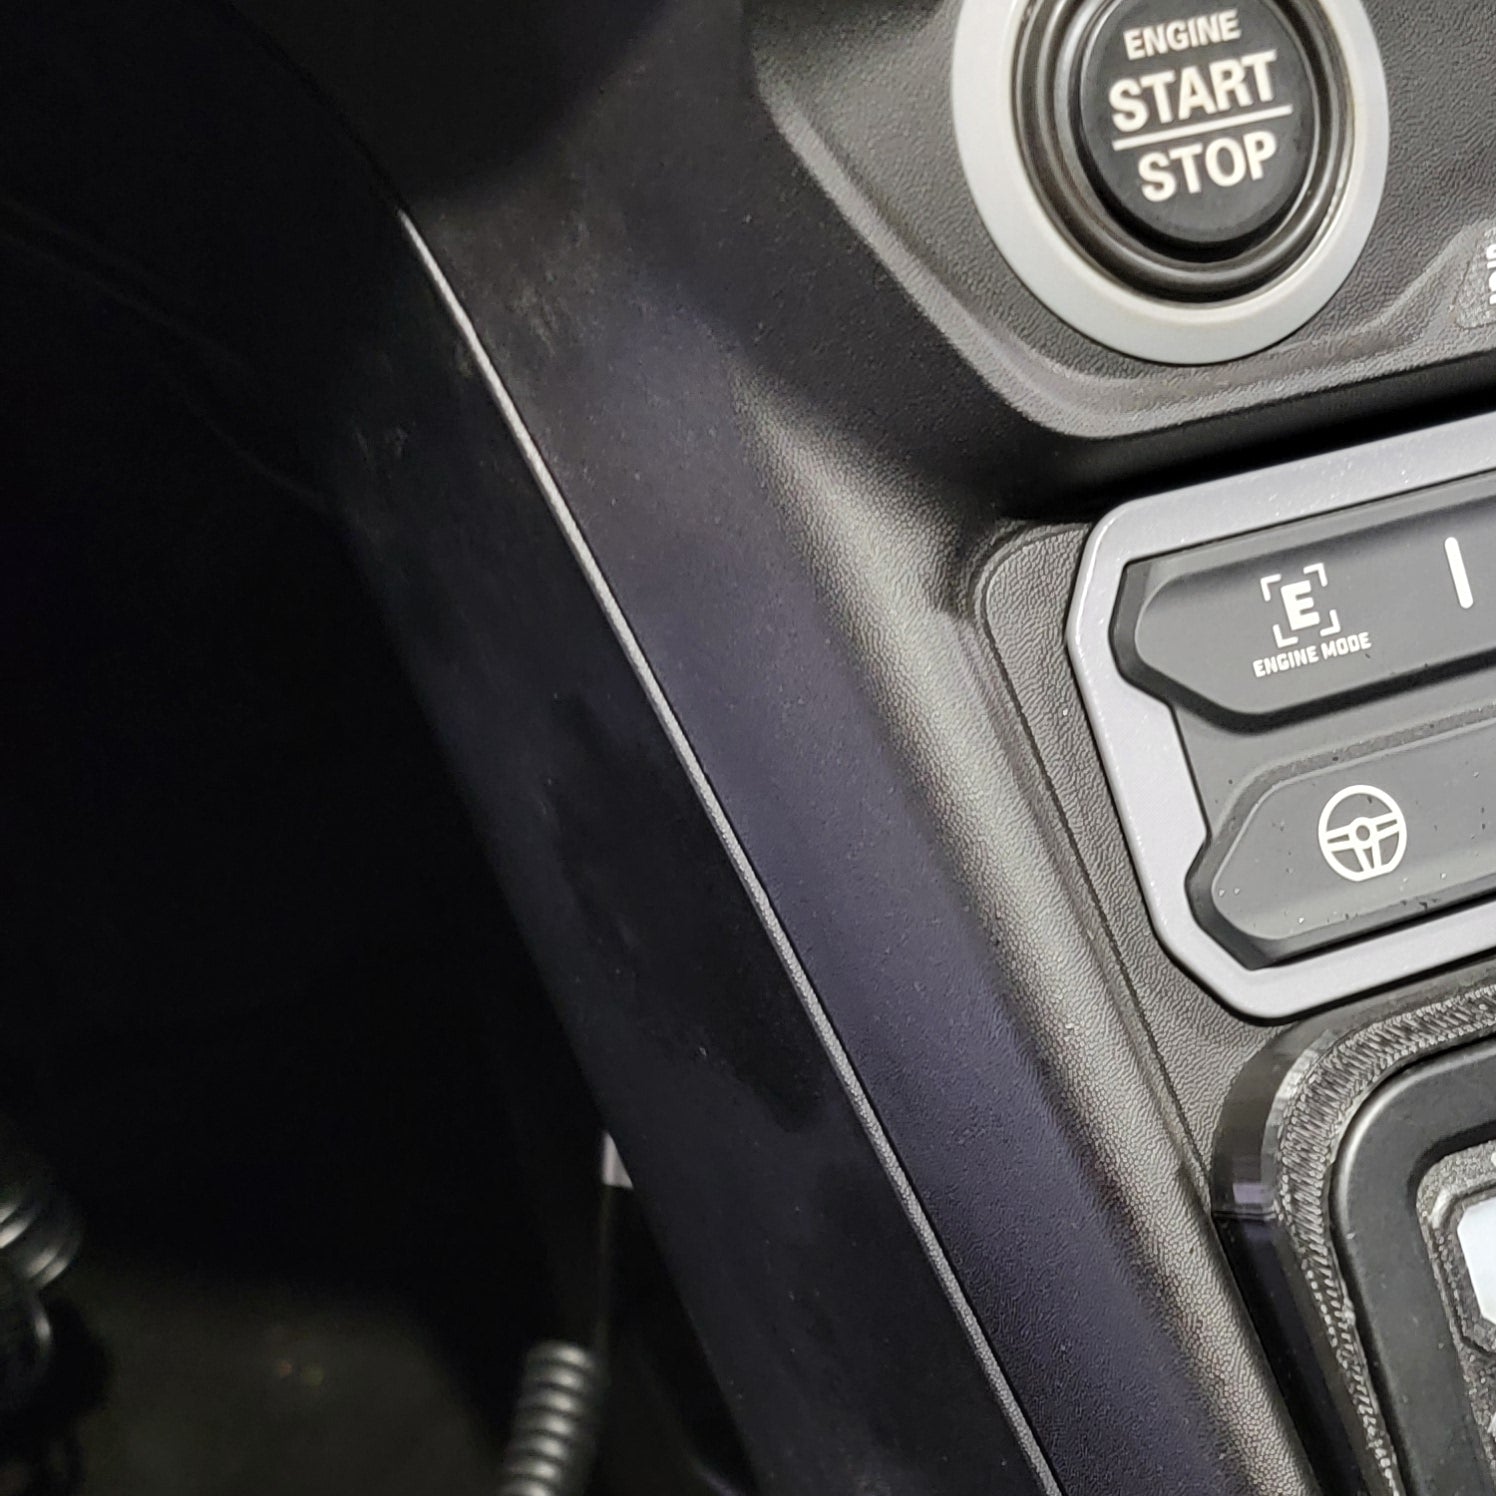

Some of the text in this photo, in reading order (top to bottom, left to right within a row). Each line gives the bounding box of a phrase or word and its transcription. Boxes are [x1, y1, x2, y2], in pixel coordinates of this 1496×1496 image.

[1123, 9, 1241, 61] ENGINE
[1108, 49, 1277, 132] START
[1138, 130, 1277, 202] STOP
[1280, 580, 1320, 631] E
[1253, 632, 1372, 678] ENGINE MODE
